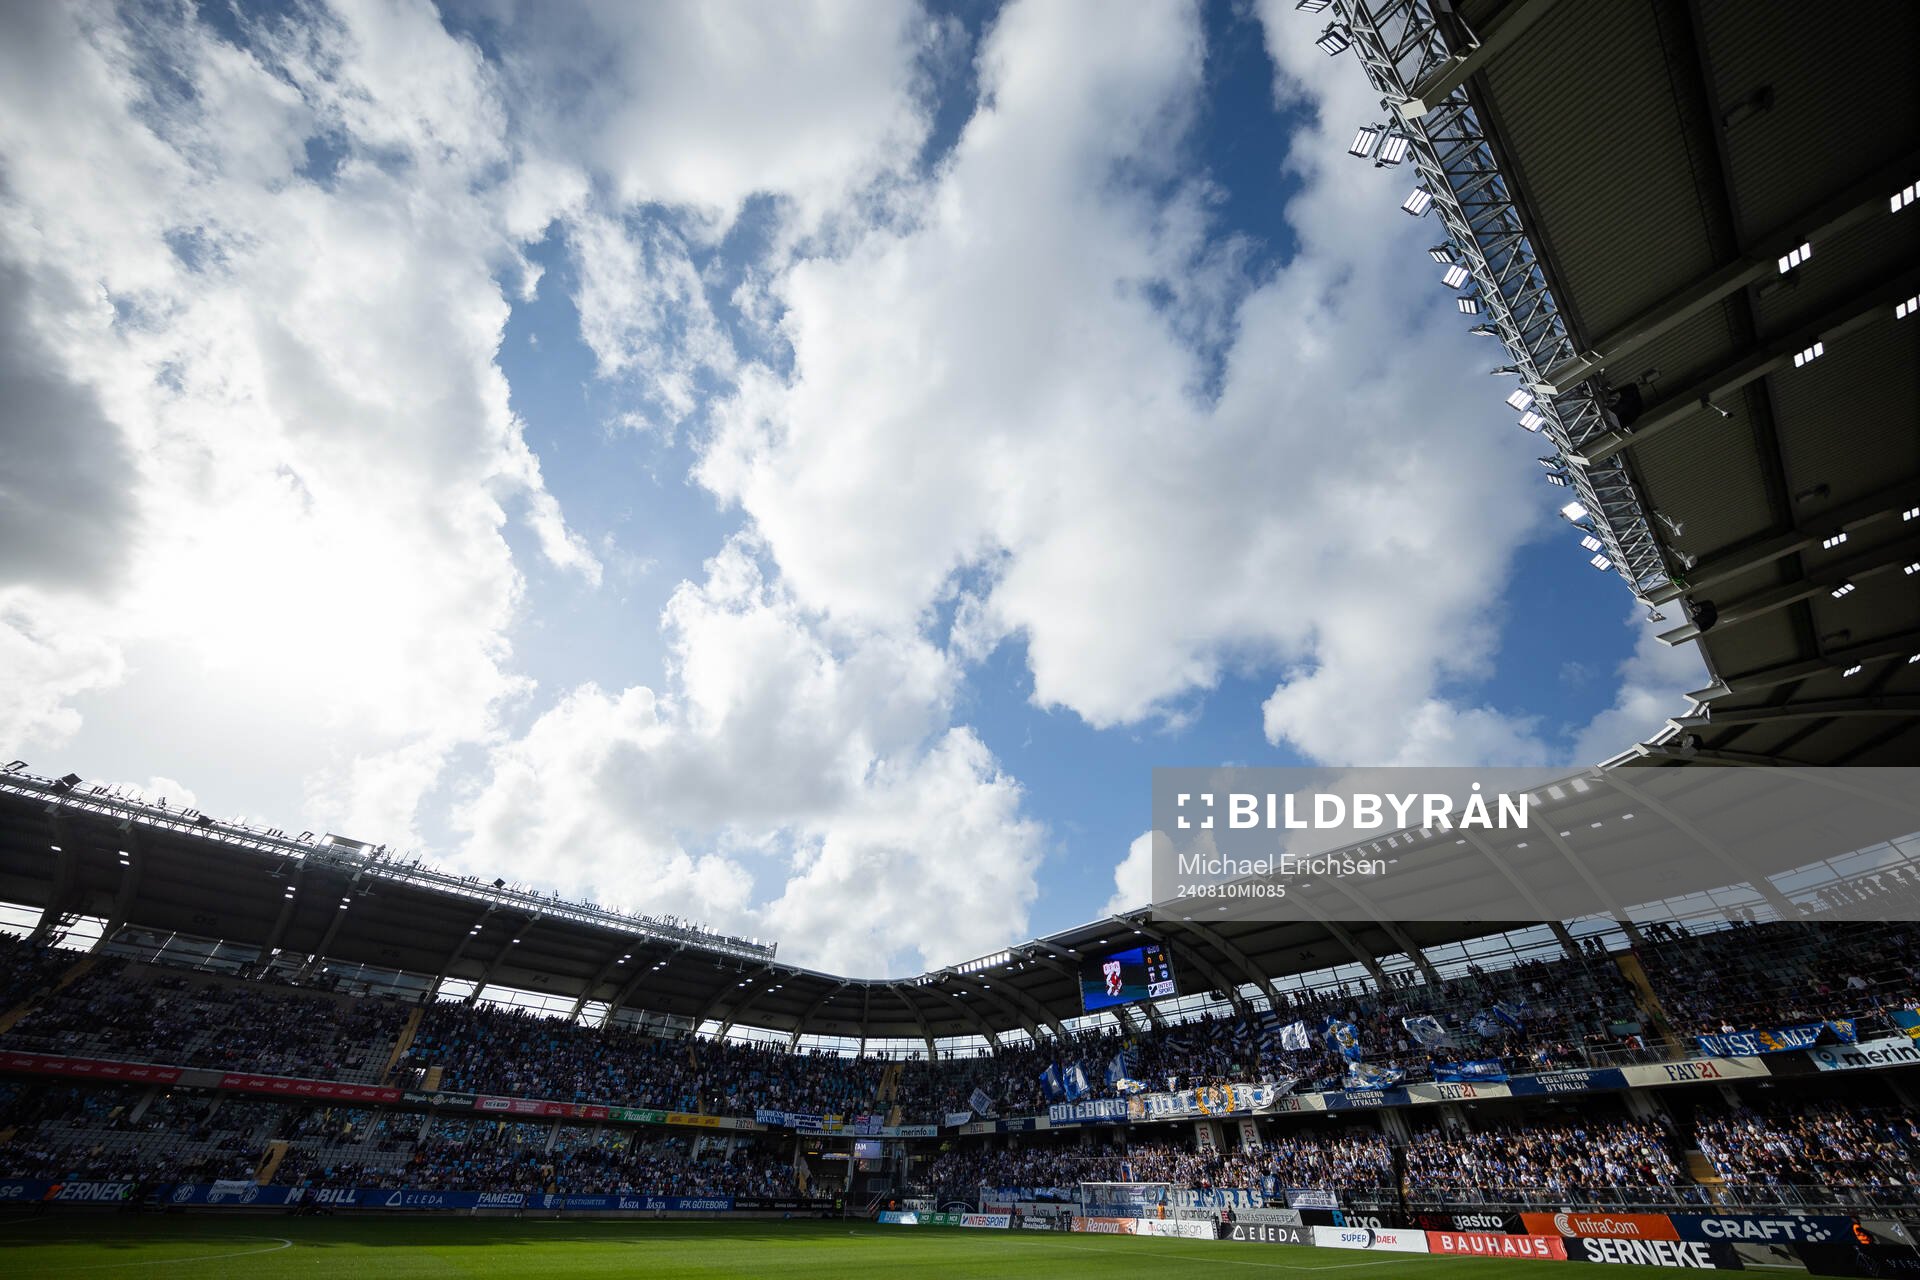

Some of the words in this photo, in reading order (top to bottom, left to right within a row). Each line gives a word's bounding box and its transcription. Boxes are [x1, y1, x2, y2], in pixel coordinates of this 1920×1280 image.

[1700, 1033, 1765, 1057] WISE
[1536, 1072, 1590, 1085] LEGENDENS
[1663, 1062, 1721, 1081] FAT21
[1437, 1082, 1477, 1100] FAT21
[1545, 1081, 1589, 1092] UTVALDA
[1345, 1090, 1385, 1100] LEGENDENS
[1351, 1098, 1384, 1107] UTVALDA
[1049, 1099, 1126, 1121] GÖTEBORG
[50, 1181, 138, 1200] ERNEK
[477, 1192, 524, 1204] FAMECO
[406, 1194, 443, 1205] ELEDA
[692, 1199, 729, 1209] GÖTEBORG
[1145, 1207, 1174, 1217] graor
[967, 1215, 1008, 1227] INTERSPORT
[1086, 1218, 1120, 1233] Renova
[1452, 1212, 1504, 1230] gastro
[1575, 1218, 1640, 1235] InfraCom
[1250, 1226, 1300, 1243] ELEDA
[1341, 1233, 1367, 1242] SUPER
[1701, 1219, 1796, 1240] CRAFT
[1441, 1235, 1549, 1255] BAUHAUS
[1582, 1237, 1716, 1269] SERNEKE
